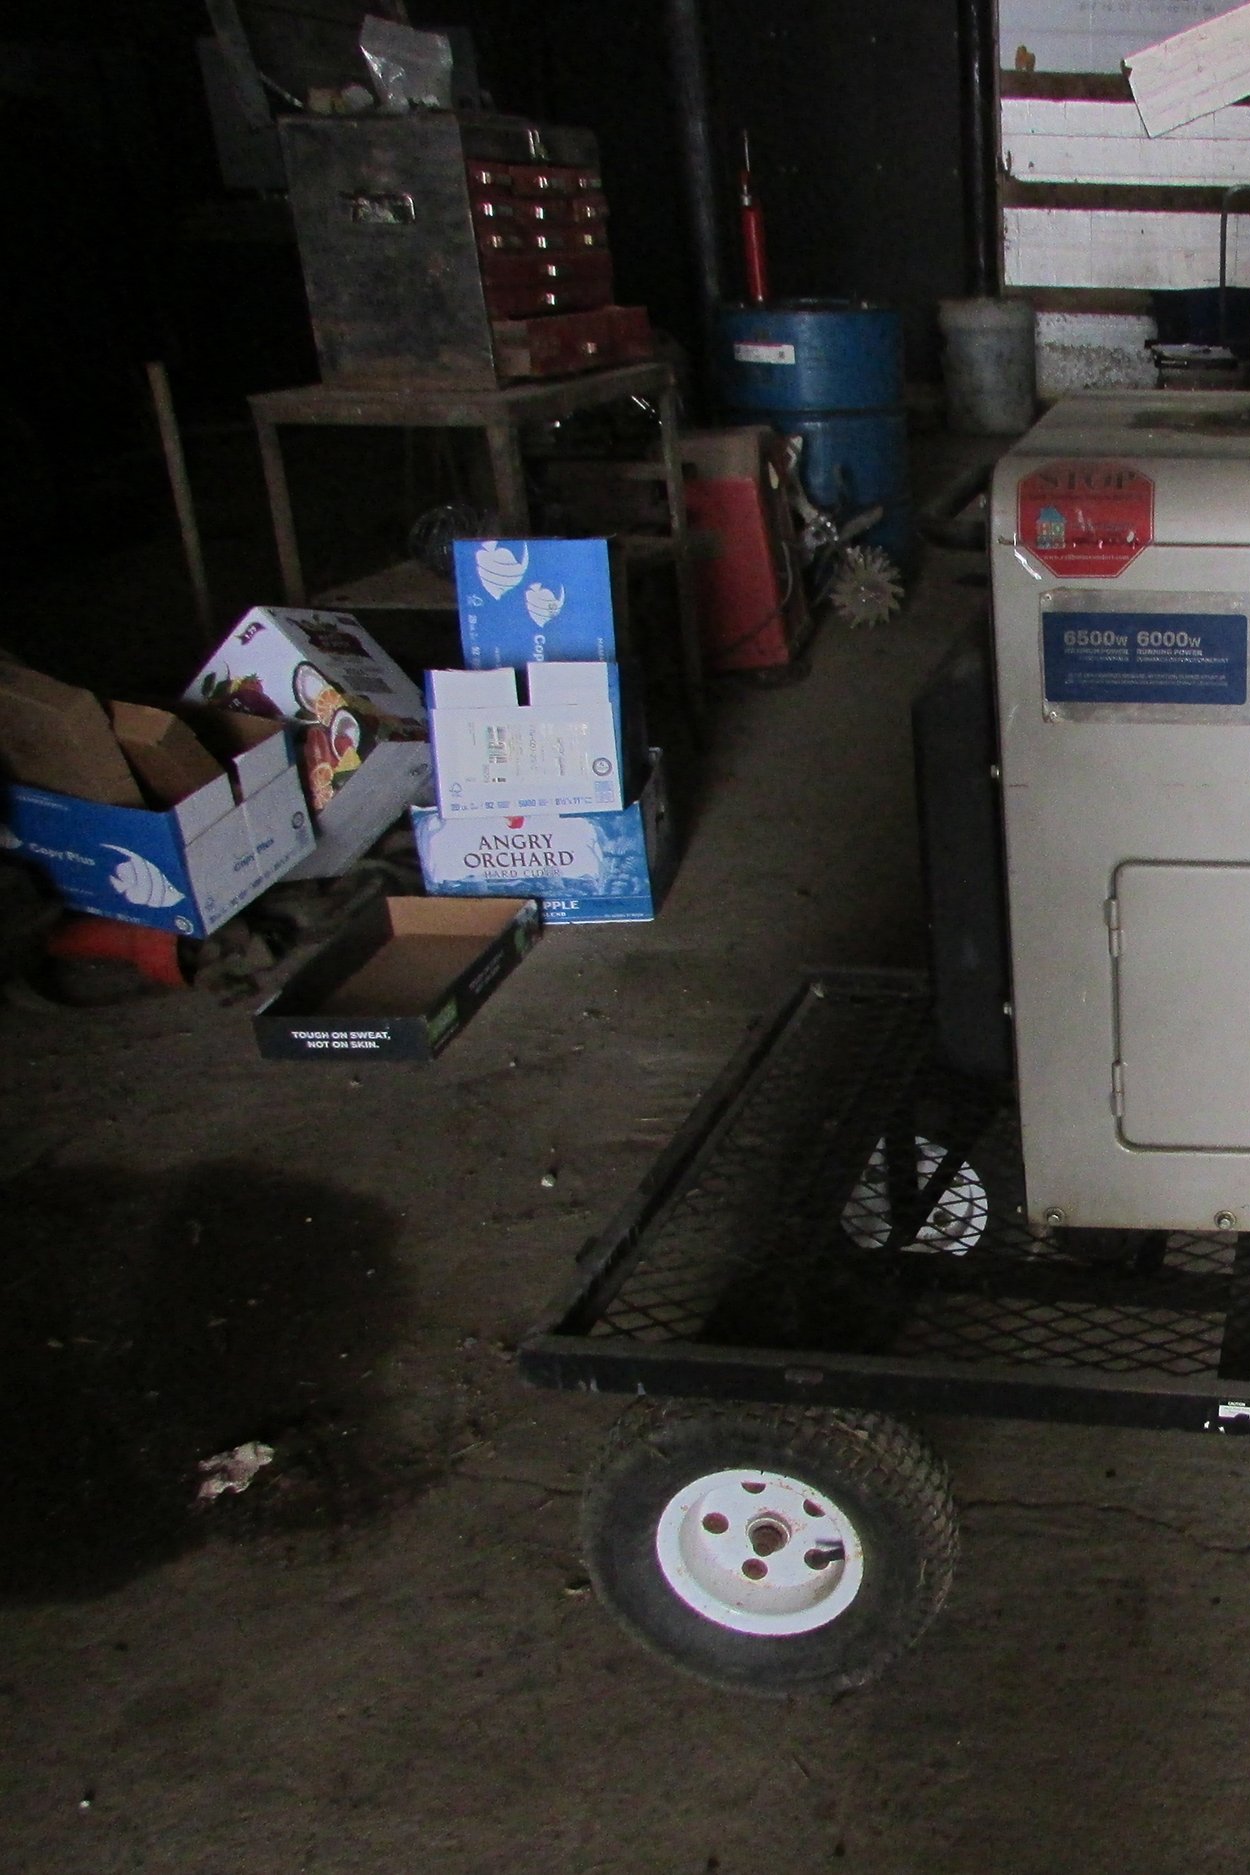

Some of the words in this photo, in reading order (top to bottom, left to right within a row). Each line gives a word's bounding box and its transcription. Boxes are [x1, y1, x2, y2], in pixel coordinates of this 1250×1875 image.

[533, 634, 546, 662] Cop
[478, 833, 553, 851] ANGRY
[28, 842, 65, 861] Copy
[65, 850, 96, 867] Plus
[463, 850, 575, 869] ORCHARD
[484, 870, 518, 879] HARD
[522, 868, 561, 878] CIDER
[542, 900, 580, 910] PPLE
[291, 1031, 330, 1039] TOUGH
[331, 1031, 348, 1039] ON
[349, 1031, 392, 1041] SWEAT,
[306, 1040, 331, 1048] NOT
[332, 1040, 349, 1048] ON
[349, 1040, 380, 1049] SKIN.
